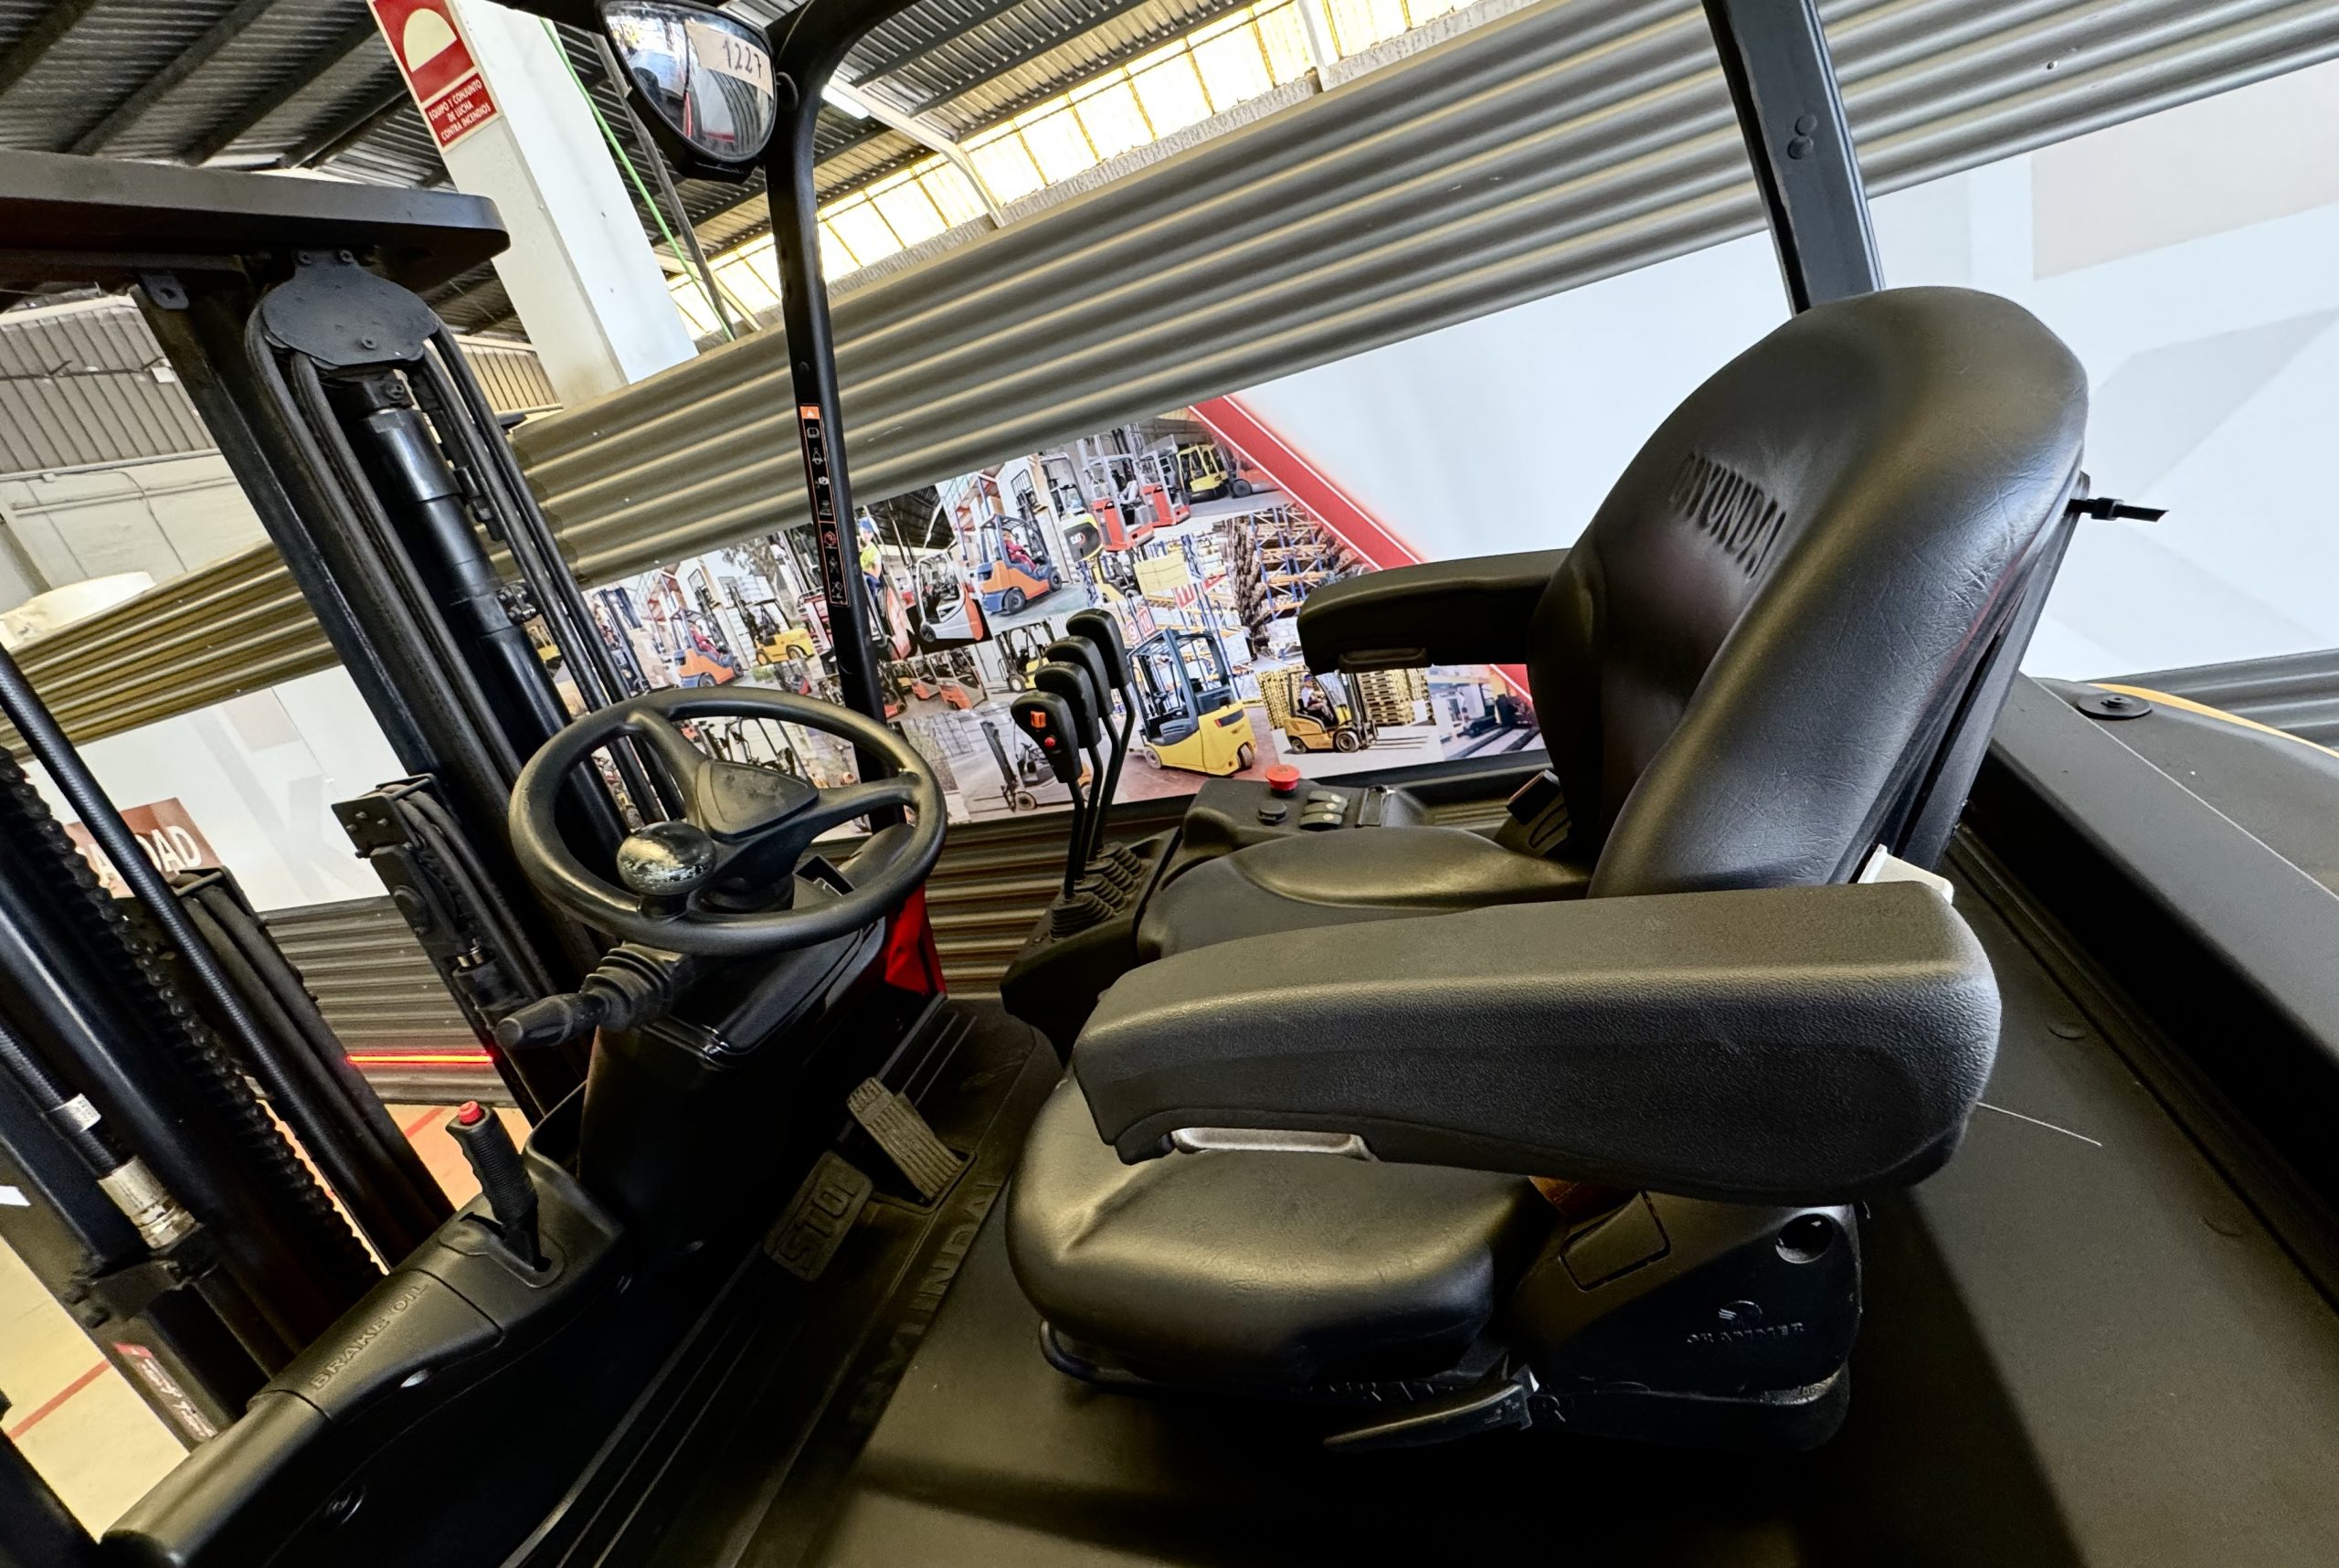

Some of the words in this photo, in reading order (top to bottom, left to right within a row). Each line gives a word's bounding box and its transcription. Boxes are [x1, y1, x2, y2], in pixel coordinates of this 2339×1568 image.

[723, 39, 762, 79] 1227
[428, 101, 450, 122] EQUIPO
[447, 98, 454, 108] Y
[452, 79, 482, 104] CONJUNTO
[446, 111, 457, 123] DE
[453, 100, 474, 118] LUCHA
[440, 121, 463, 141] CONTRA
[460, 101, 492, 128] INCENDIOS
[312, 1317, 390, 1390] BRAKE
[391, 1284, 429, 1314] OIL
